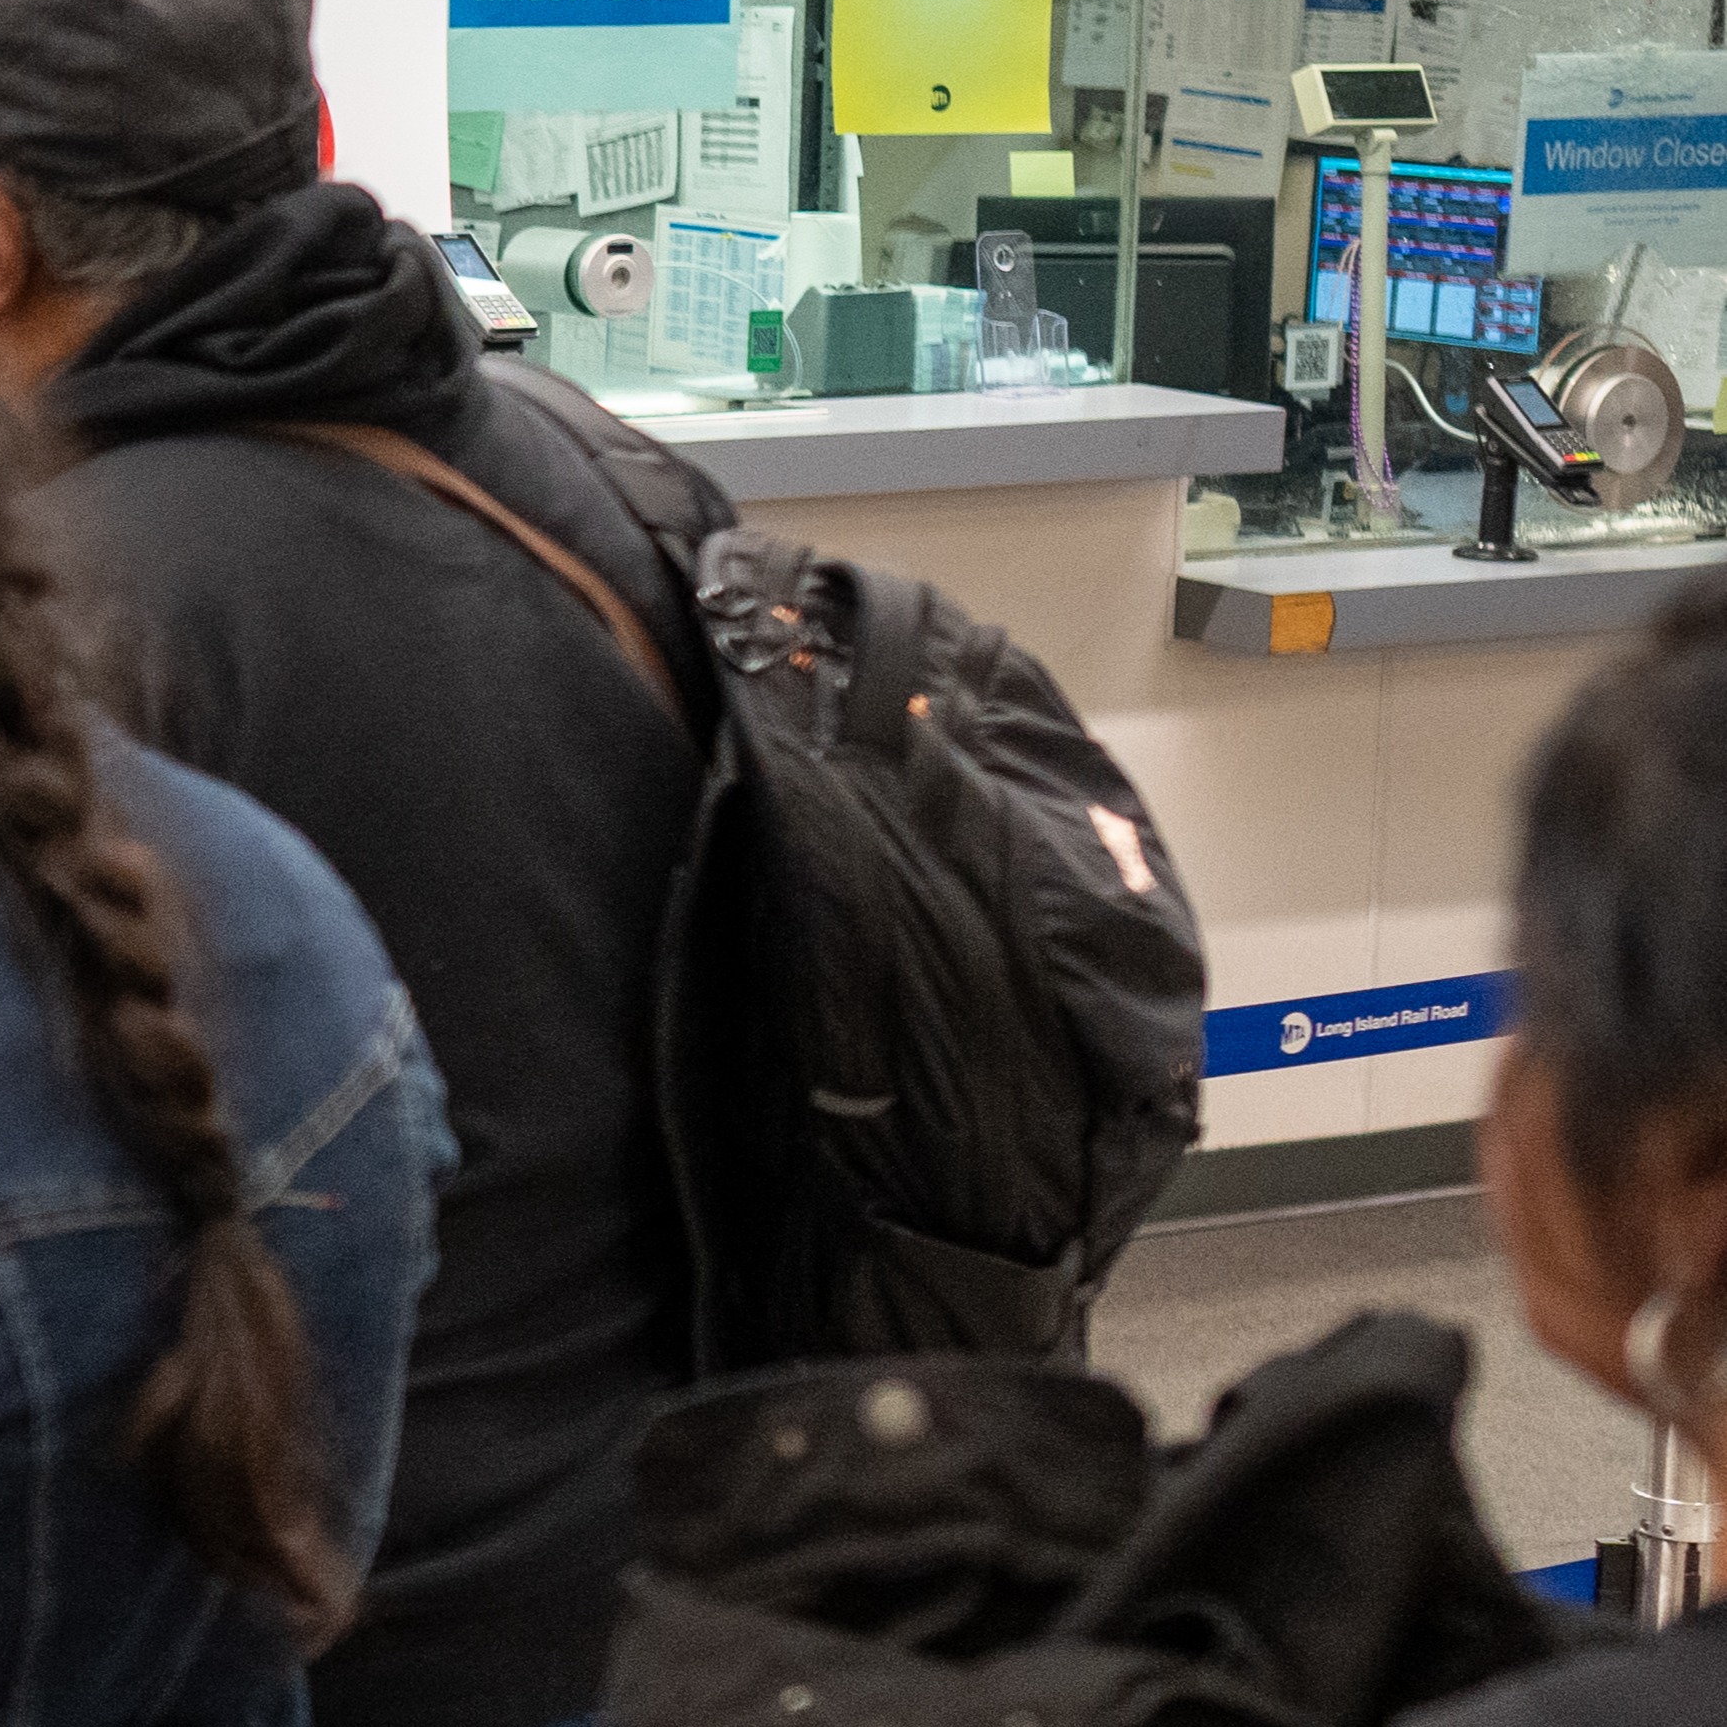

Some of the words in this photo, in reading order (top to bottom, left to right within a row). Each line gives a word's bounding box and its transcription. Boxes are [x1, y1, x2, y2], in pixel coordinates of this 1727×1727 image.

[1544, 139, 1646, 172] Window
[1652, 135, 1727, 168] Close
[1315, 1021, 1354, 1038] Long
[1354, 1012, 1398, 1033] Island
[1399, 1007, 1429, 1025] Rail
[1430, 1001, 1469, 1021] Road
